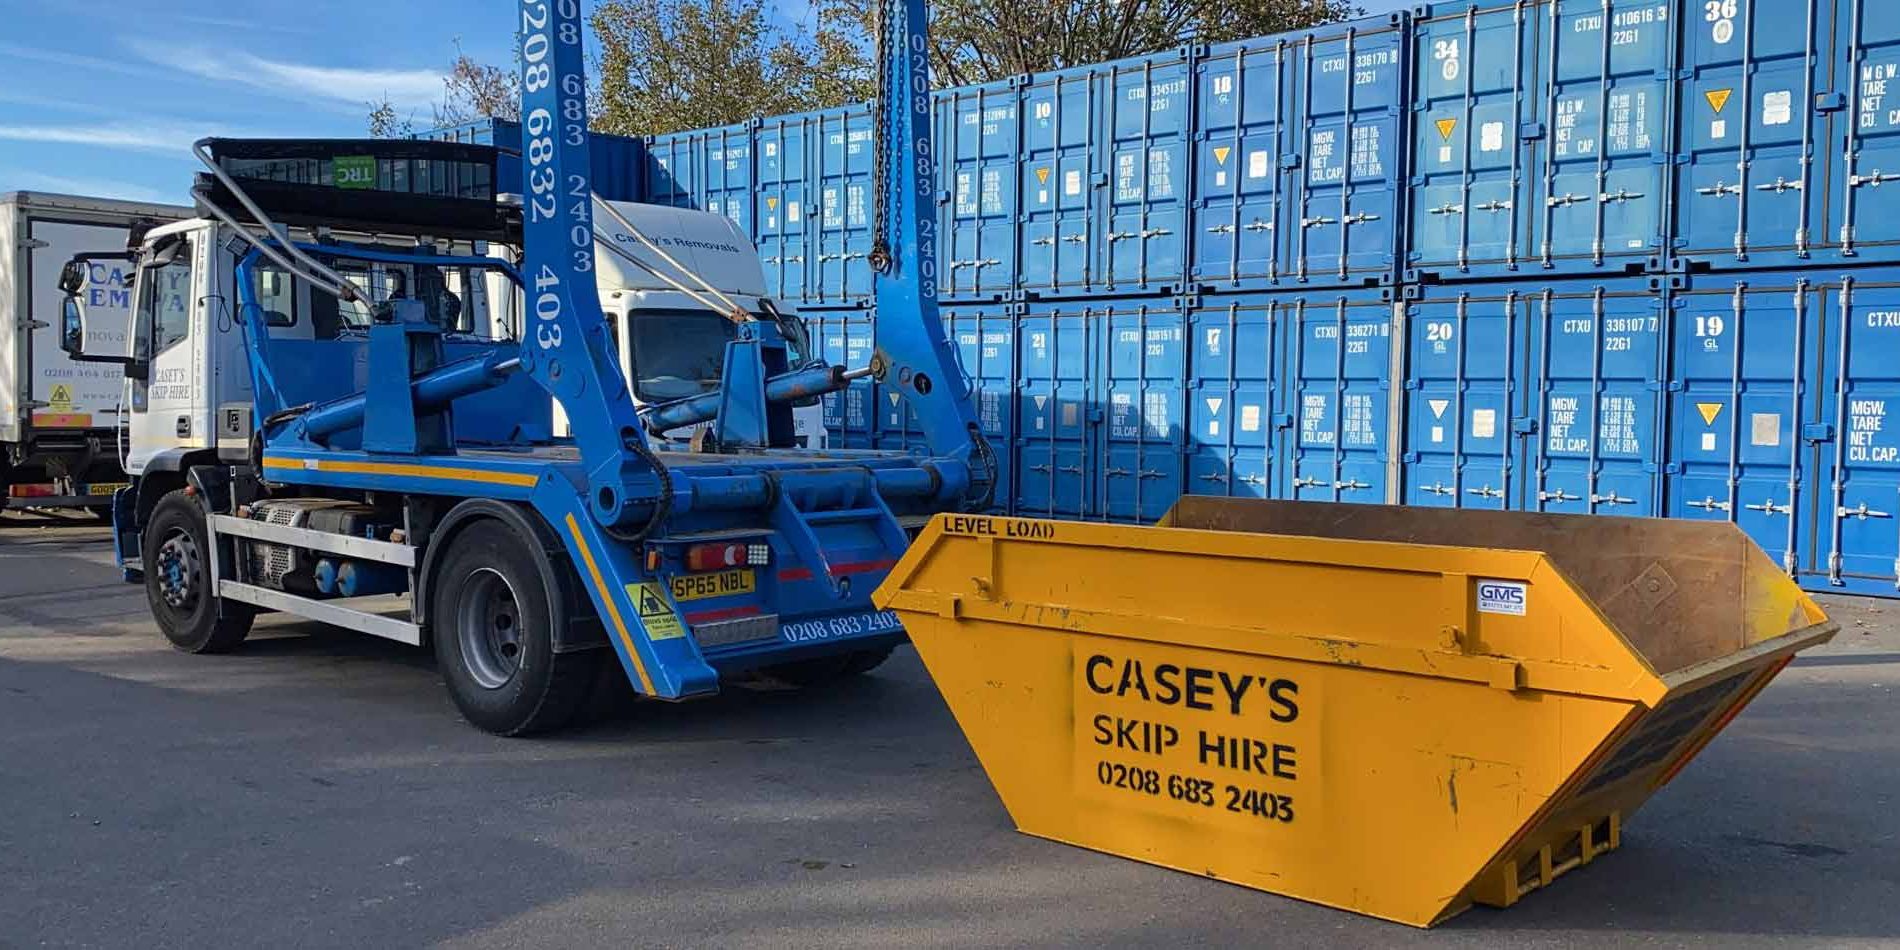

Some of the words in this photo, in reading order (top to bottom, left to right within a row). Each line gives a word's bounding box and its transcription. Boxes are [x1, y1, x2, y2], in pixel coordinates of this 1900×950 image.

[1705, 0, 1737, 21] 36
[1575, 18, 1601, 32] CTXU
[1614, 9, 1653, 27] 410616
[1613, 30, 1639, 45] 22G1
[522, 0, 551, 93] 208
[1434, 39, 1459, 59] 34
[1322, 59, 1345, 72] CTXU
[911, 34, 928, 114] 0208
[1356, 72, 1376, 84] 22G1
[1863, 80, 1887, 96] TARE
[562, 74, 584, 146] 683
[1861, 96, 1882, 112] NET
[1557, 114, 1577, 127] TARE
[1861, 112, 1878, 128] CU.
[1556, 127, 1572, 141] NET
[1313, 144, 1333, 156] TARE
[527, 108, 557, 223] 6832
[916, 138, 931, 196] 683
[1312, 157, 1327, 168] NET
[337, 166, 374, 182] TRC
[568, 175, 592, 272] 2403
[615, 233, 672, 246] Cay's
[674, 237, 740, 254] Removals
[920, 220, 935, 298] 2403
[534, 264, 562, 349] 403
[1315, 327, 1338, 338] CTXU
[1347, 325, 1378, 337] 336271
[1426, 322, 1453, 341] 20
[1564, 319, 1591, 333] CTXU
[1606, 318, 1645, 333] 336107
[1648, 317, 1657, 332] 7
[1695, 315, 1724, 337] 19
[1348, 341, 1368, 353] 22G1
[1606, 337, 1631, 350] 22G1
[1703, 338, 1719, 349] GL
[156, 368, 185, 383] CASEY'S
[150, 385, 168, 400] SKIP
[169, 385, 190, 399] HIRE
[1304, 395, 1326, 407] MGW.
[1551, 397, 1578, 411] MGW.
[1851, 401, 1886, 415] MGW.
[1113, 415, 1126, 426] NET
[1305, 408, 1324, 419] TARE
[1552, 411, 1575, 425] TARE
[1303, 420, 1319, 431] NET
[1550, 425, 1568, 438] NET
[1852, 416, 1882, 431] TARE
[1550, 438, 1566, 451] CU.
[1568, 439, 1590, 452] CAP.
[1850, 431, 1874, 446] NET
[1850, 446, 1870, 461] CU.
[1872, 447, 1900, 462] CAP.
[943, 517, 998, 535] LEVEL
[1006, 520, 1055, 539] LOAD
[675, 576, 716, 598] SP65
[720, 571, 750, 592] NBL
[1480, 584, 1524, 605] GMS
[782, 620, 829, 643] 0208
[829, 615, 862, 636] 683
[862, 609, 902, 632] 2403
[1085, 654, 1300, 724] CASEY'S
[1093, 713, 1180, 756] SKIP
[1198, 730, 1298, 781] HIRE
[1097, 760, 1161, 796] 0208
[1167, 774, 1215, 808] 683
[1225, 785, 1295, 824] 2403
